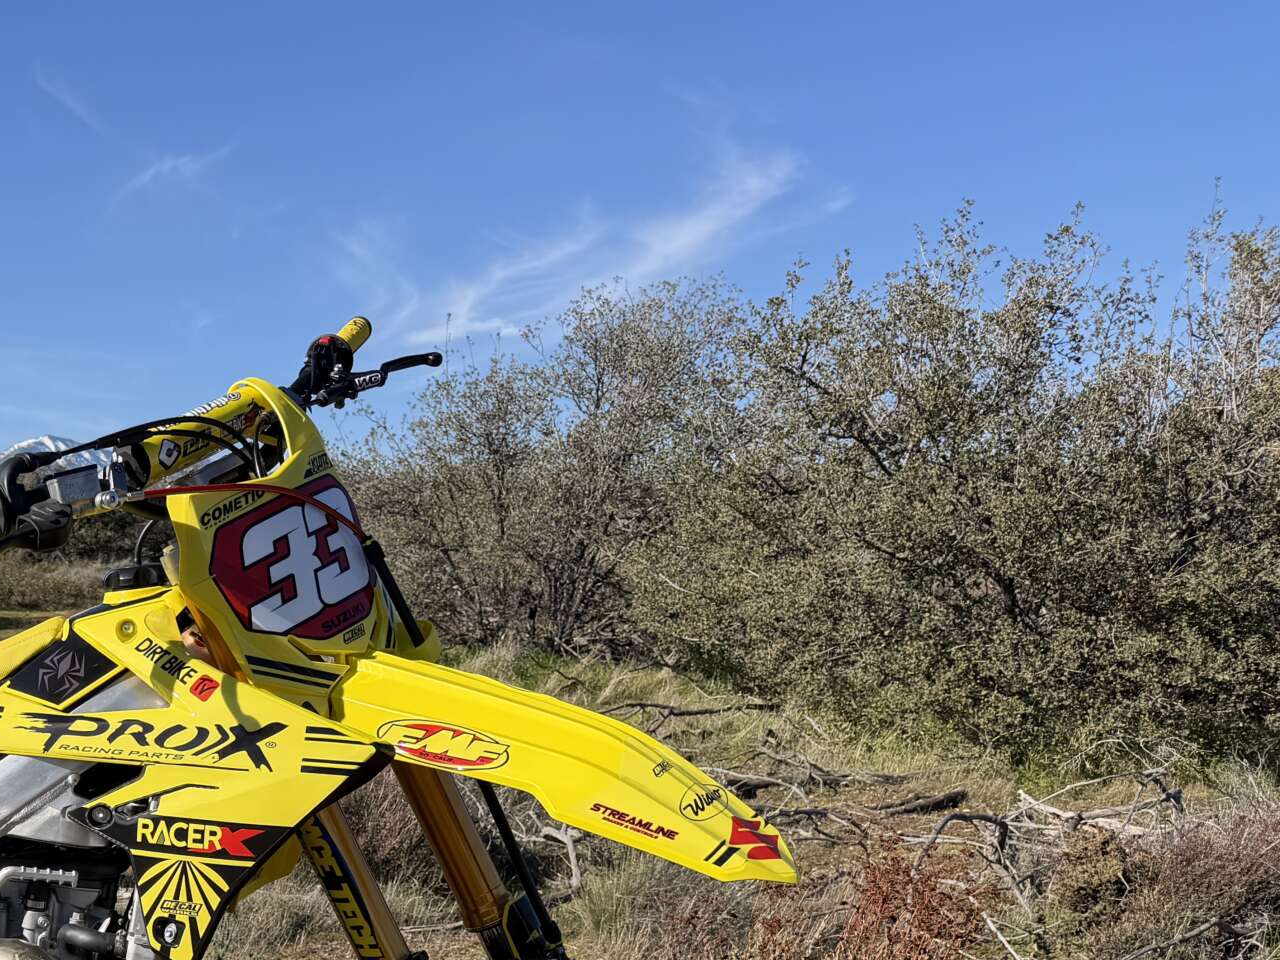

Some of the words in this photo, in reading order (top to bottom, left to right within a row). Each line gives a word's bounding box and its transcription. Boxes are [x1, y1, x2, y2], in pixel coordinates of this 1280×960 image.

[242, 486, 370, 634] 33
[321, 603, 366, 633] SUZUKI
[134, 637, 171, 664] DIRT
[161, 655, 198, 685] BIKE
[58, 743, 124, 756] RACING
[128, 749, 185, 761] PARTS
[379, 724, 511, 762] FMF
[590, 803, 680, 841] STREAMLINE
[161, 900, 202, 913] DECAL
[329, 883, 385, 958] TECH
